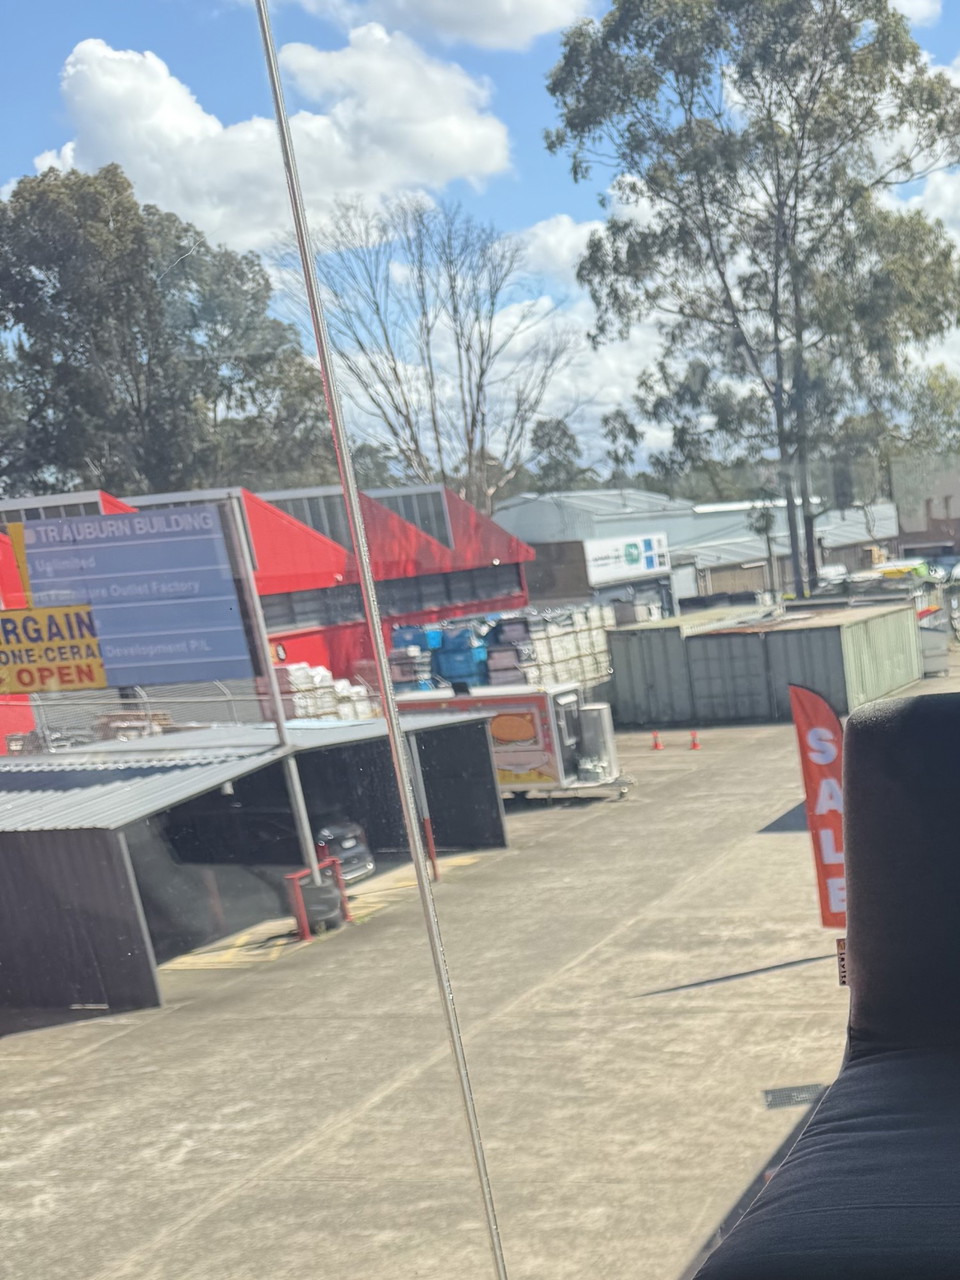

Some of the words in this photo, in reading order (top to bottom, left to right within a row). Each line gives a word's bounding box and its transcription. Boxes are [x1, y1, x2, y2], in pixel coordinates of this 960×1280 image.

[133, 512, 214, 535] BUILDING
[0, 611, 98, 645] RGAIN
[16, 663, 95, 688] OPEN
[806, 727, 847, 913] SALE
